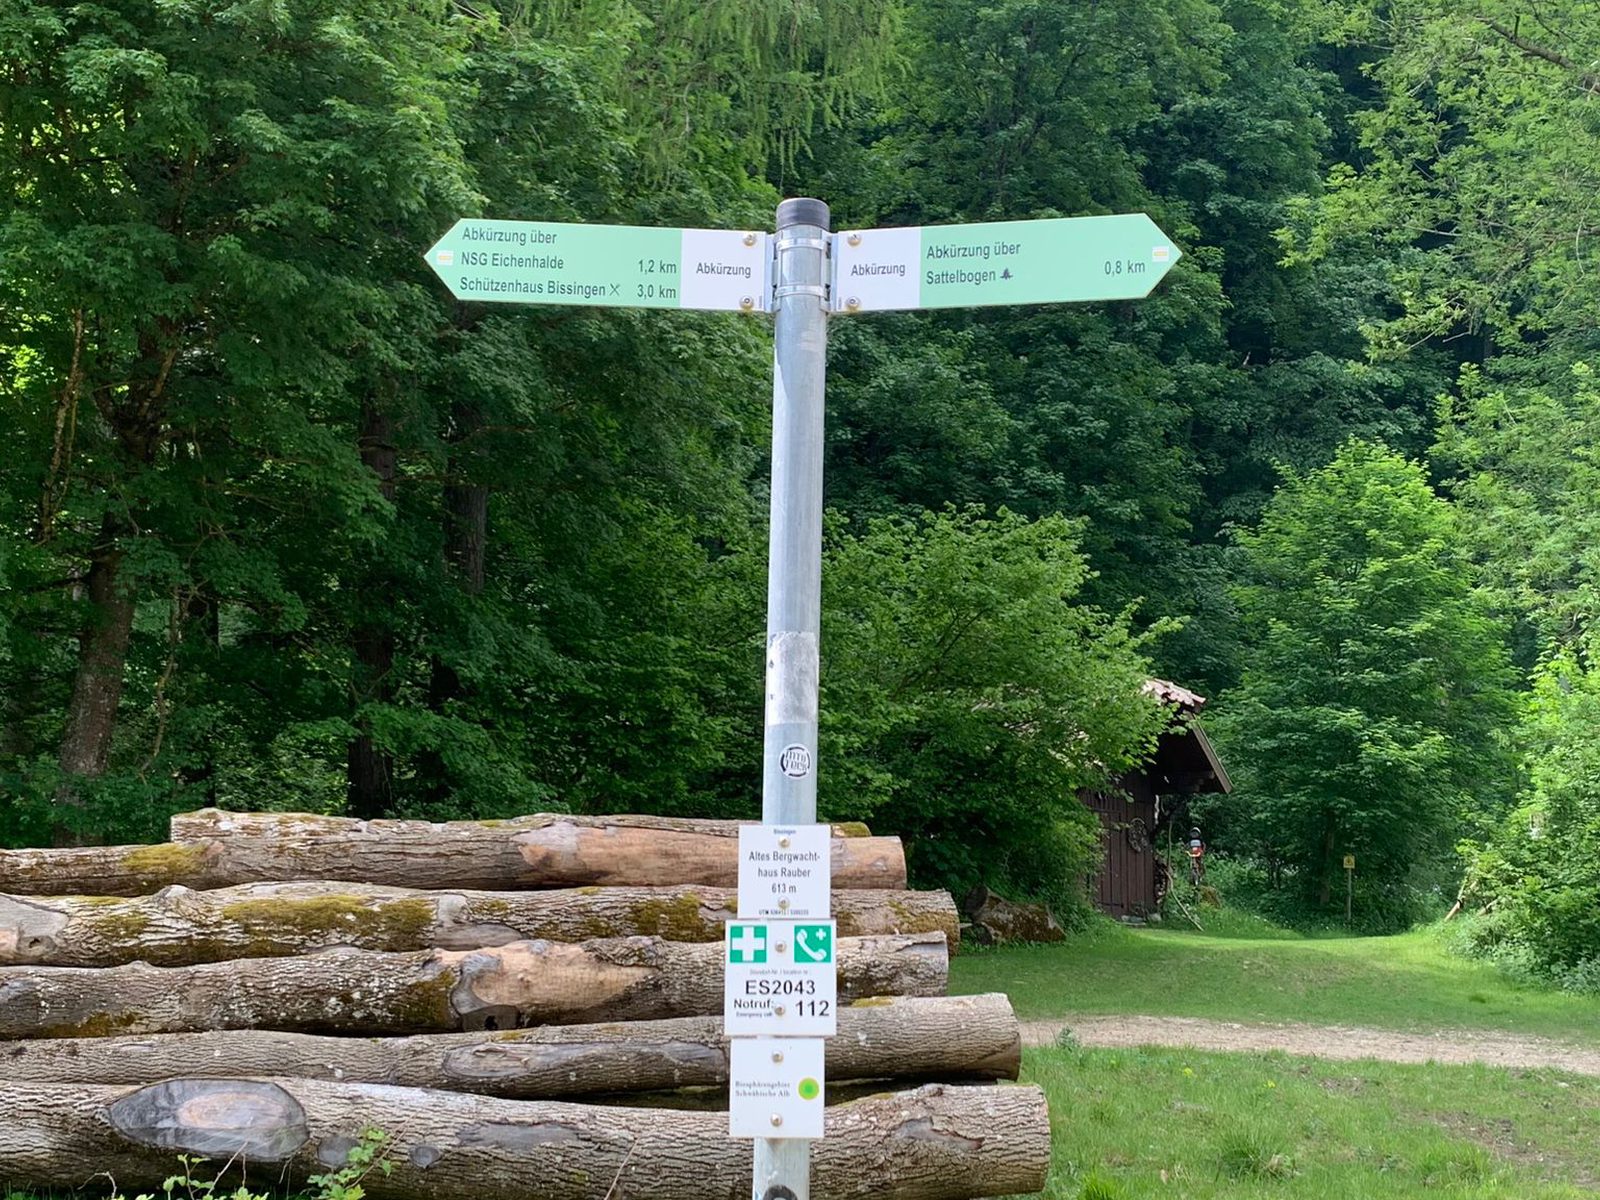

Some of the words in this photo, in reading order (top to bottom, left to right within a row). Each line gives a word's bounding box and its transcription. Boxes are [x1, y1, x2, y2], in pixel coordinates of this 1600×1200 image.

[462, 226, 527, 246] Abkürzung
[530, 229, 557, 245] über
[927, 242, 990, 260] Abkürzung
[994, 241, 1021, 256] über
[461, 252, 488, 266] NSG
[491, 252, 564, 270] Eichenhalde
[638, 259, 655, 275] 1,2
[660, 260, 677, 275] km
[1104, 259, 1122, 277] 0,8
[1127, 259, 1146, 274] km
[696, 262, 751, 279] Abkürzung
[851, 262, 906, 278] Abkürzung
[926, 269, 996, 286] Sattelbogen
[460, 276, 544, 294] Schützenhaus
[548, 280, 606, 299] Bissingen
[637, 284, 654, 300] 3,0
[659, 285, 676, 299] km
[749, 851, 771, 861] Altes
[772, 851, 820, 863] Bergwacht-
[757, 867, 778, 877] haus
[780, 867, 811, 877] Rauber
[771, 883, 787, 893] 613
[788, 885, 797, 893] m
[745, 980, 816, 995] ES2043
[795, 1000, 830, 1017] 112
[778, 1089, 791, 1097] Alb
